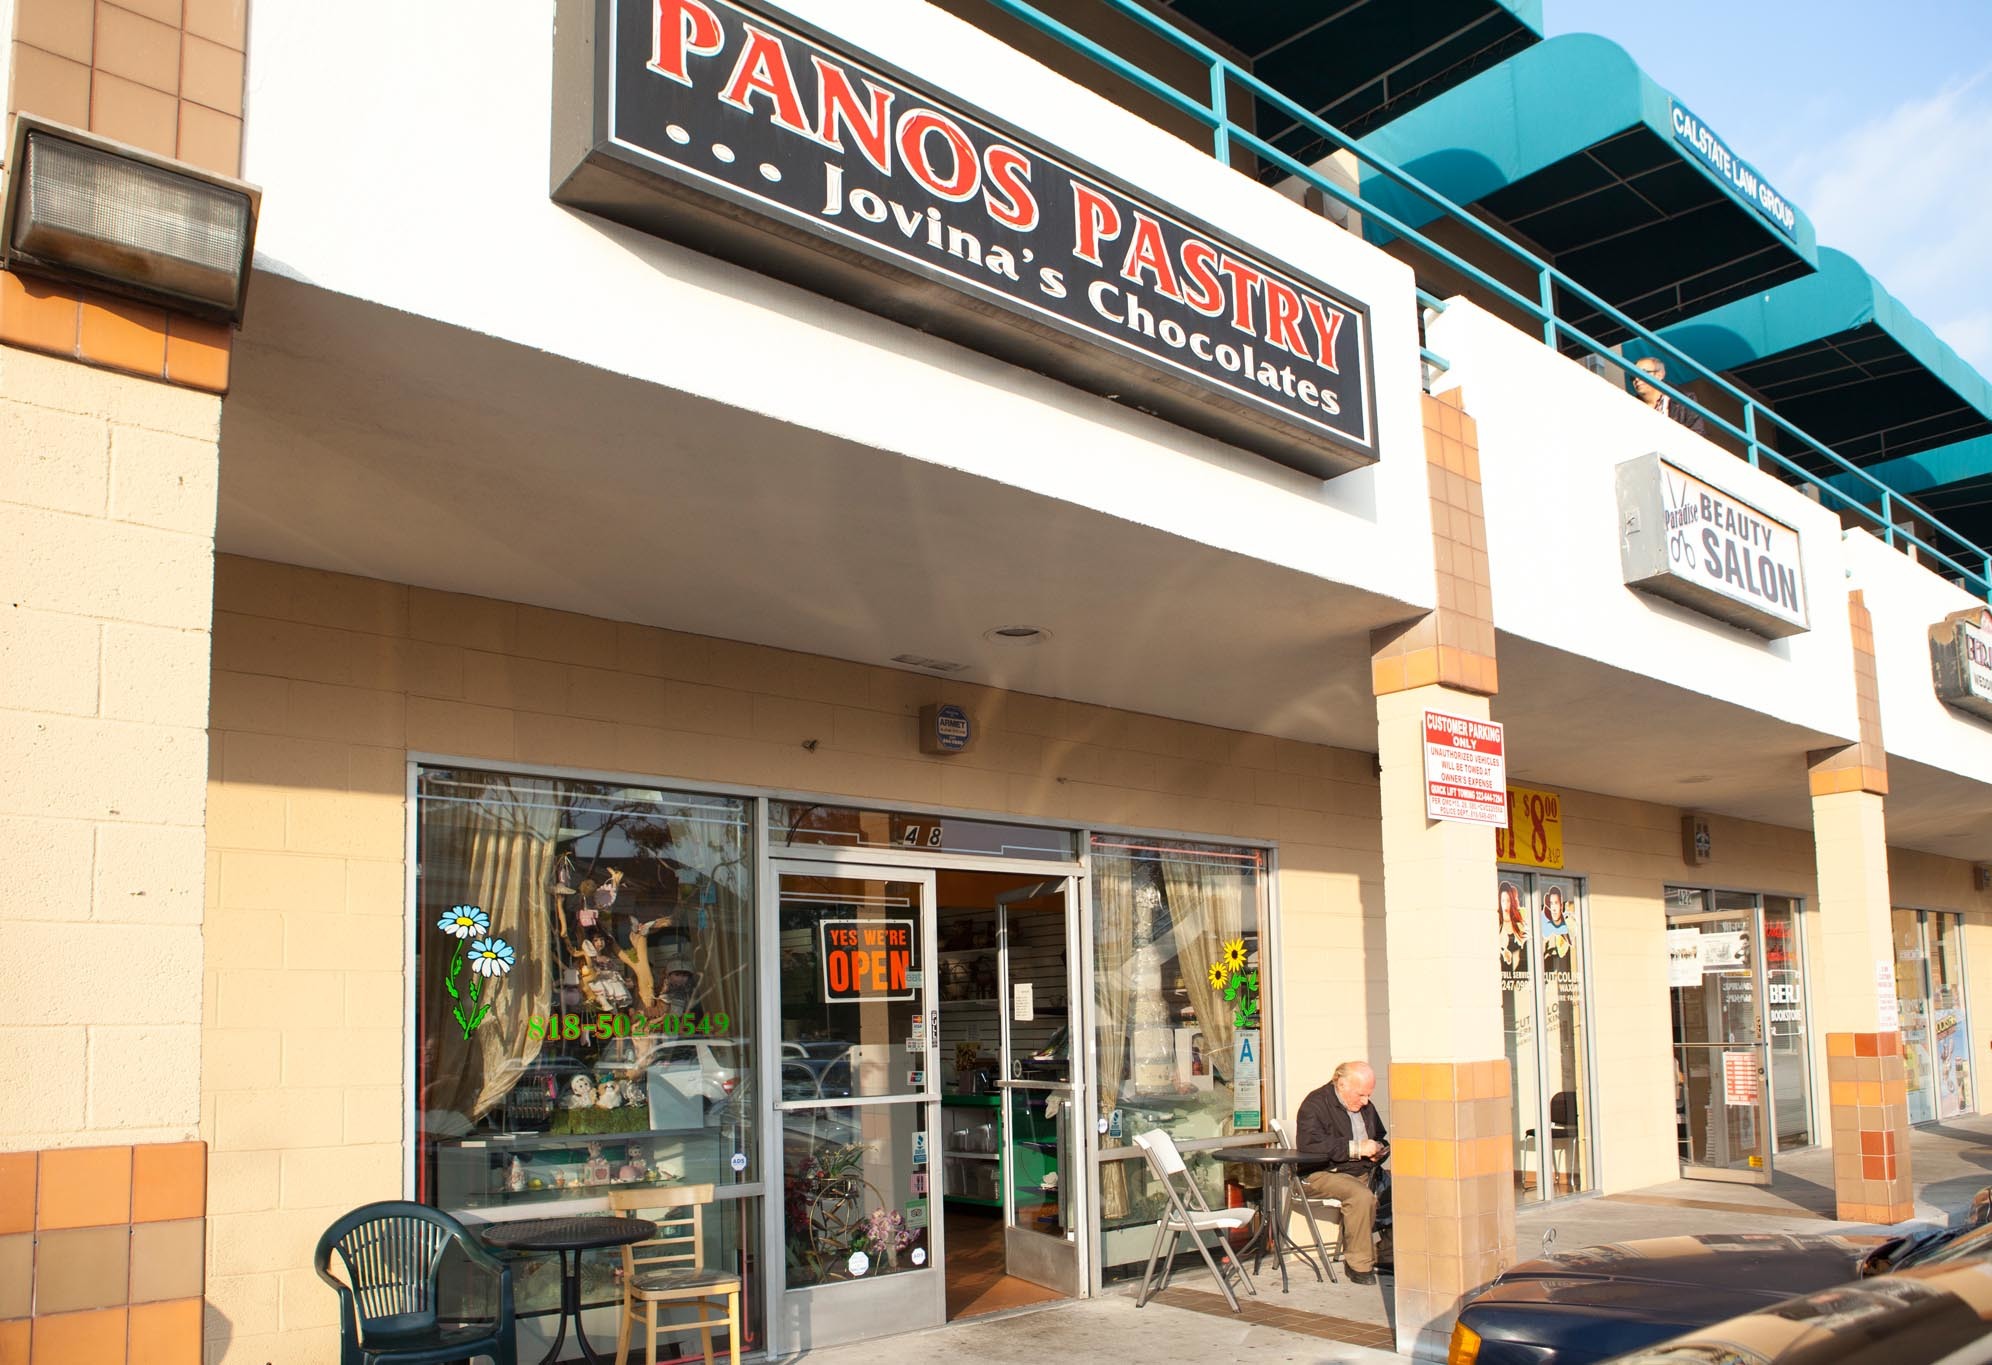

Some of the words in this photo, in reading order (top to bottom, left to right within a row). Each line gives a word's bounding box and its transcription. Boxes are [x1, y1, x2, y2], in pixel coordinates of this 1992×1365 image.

[1672, 107, 1731, 179] CALSTATE
[1732, 159, 1757, 199] LAW
[1758, 184, 1795, 231] GROUP
[646, 0, 1039, 233] PANOS
[1069, 179, 1344, 375] PASTRY
[821, 161, 1067, 299] Jovina's
[1088, 280, 1341, 416] Chocolates
[1665, 503, 1699, 531] Paradise
[1700, 492, 1772, 552] BEAUTY
[1702, 527, 1799, 613] SALON
[1426, 713, 1467, 736] CUSTOMER
[1468, 722, 1500, 743] PARKING
[1452, 735, 1476, 749] ONLY
[1430, 746, 1473, 761] UNAUTHORIZED
[1475, 754, 1499, 767] VEHICLES
[1441, 760, 1454, 770] WILL
[1456, 762, 1463, 771] BE
[1464, 764, 1483, 774] TOWED
[1484, 767, 1490, 775] AT
[1440, 772, 1466, 784] OWNER'S
[1468, 776, 1492, 788] EXPENSE
[904, 827, 916, 844] 4
[929, 827, 941, 846] 8
[830, 930, 857, 945] YES
[864, 930, 907, 945] WE'RE
[829, 951, 909, 992] OPEN
[527, 1012, 731, 1040] 818-502-0549
[1239, 1038, 1254, 1062] A
